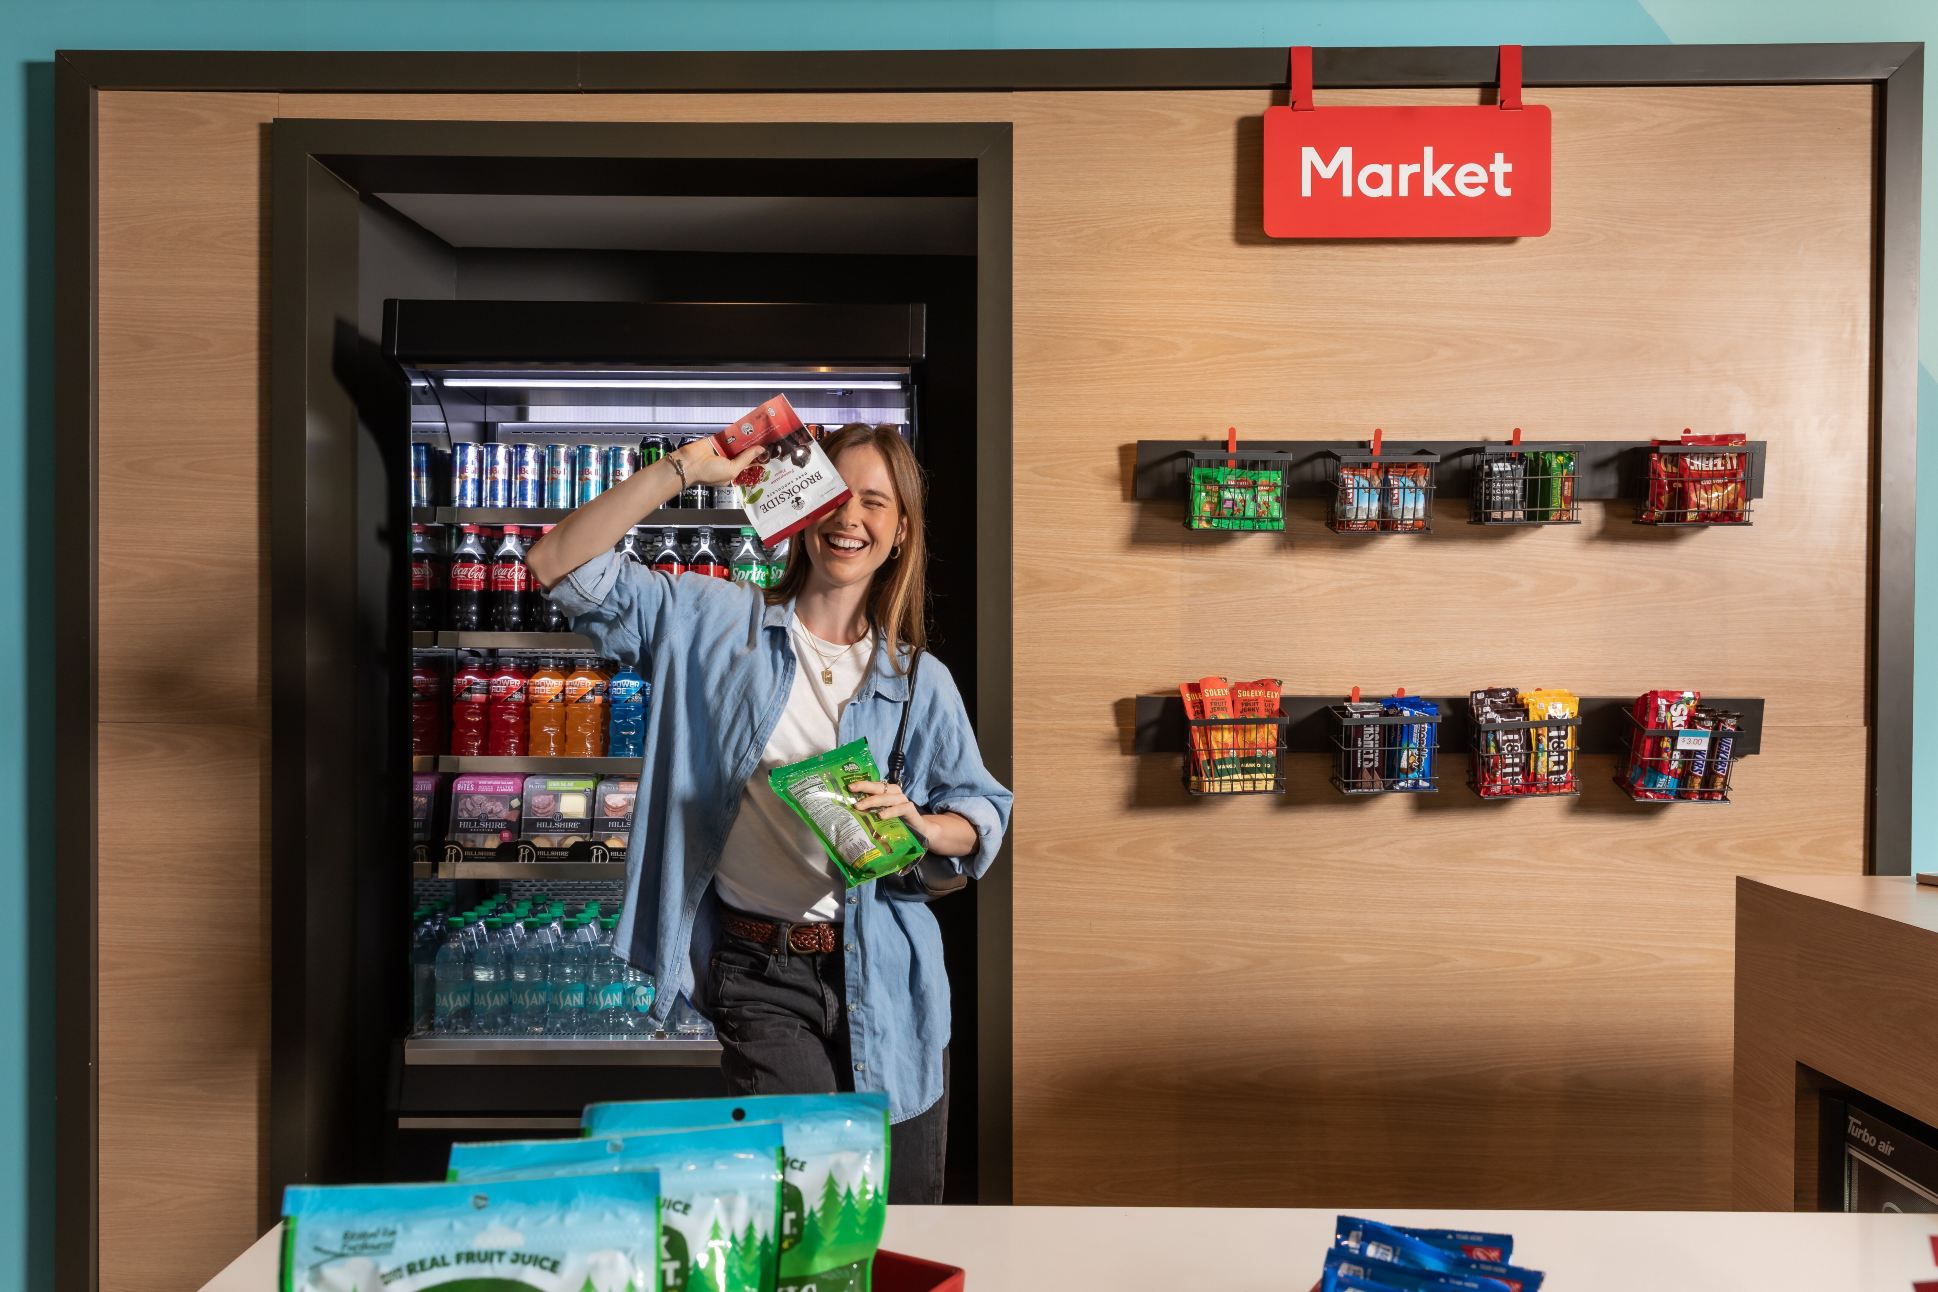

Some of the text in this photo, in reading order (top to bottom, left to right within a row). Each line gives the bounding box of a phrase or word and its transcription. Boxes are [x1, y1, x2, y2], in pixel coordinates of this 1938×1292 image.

[1301, 146, 1513, 198] Market
[759, 470, 823, 514] BROOKSIDE
[732, 567, 767, 581] Sprite
[612, 680, 640, 688] POWER
[1186, 692, 1202, 701] SOLE
[1204, 688, 1229, 698] SOLELY
[1237, 689, 1262, 698] SOLELY
[459, 821, 507, 829] HILLSHIRE
[536, 821, 580, 829] HILLSHIRE
[436, 991, 471, 1012] DASAN
[551, 990, 584, 1008] ASANI
[626, 989, 652, 1008] ASANI
[1847, 1115, 1895, 1157] Turbo air
[783, 1156, 807, 1172] ICE
[661, 1198, 692, 1216] ICE
[407, 1254, 451, 1276] REAL
[456, 1250, 507, 1266] FRUIT
[510, 1251, 561, 1274] JUICE
